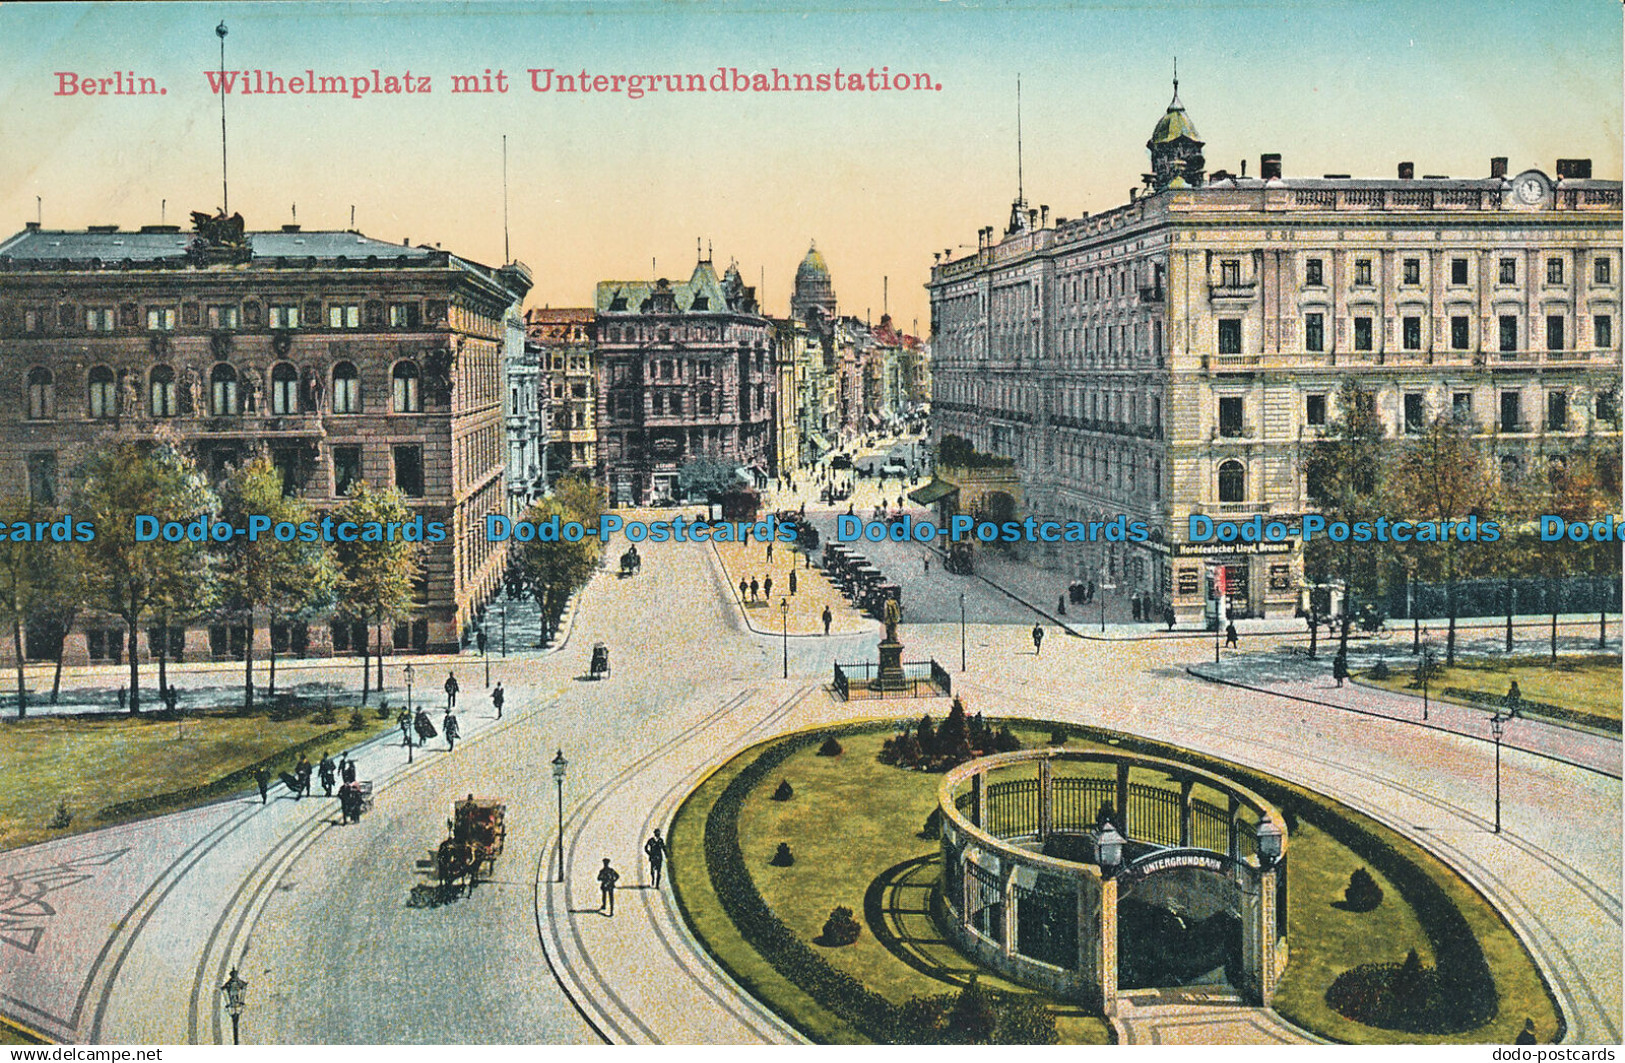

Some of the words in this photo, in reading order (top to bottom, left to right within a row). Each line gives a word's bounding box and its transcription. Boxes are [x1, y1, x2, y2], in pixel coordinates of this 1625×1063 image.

[1179, 544, 1235, 554] Norddeutscher
[1259, 542, 1289, 552] Bremen
[1142, 855, 1222, 874] UNTERGRUNDBAHN
